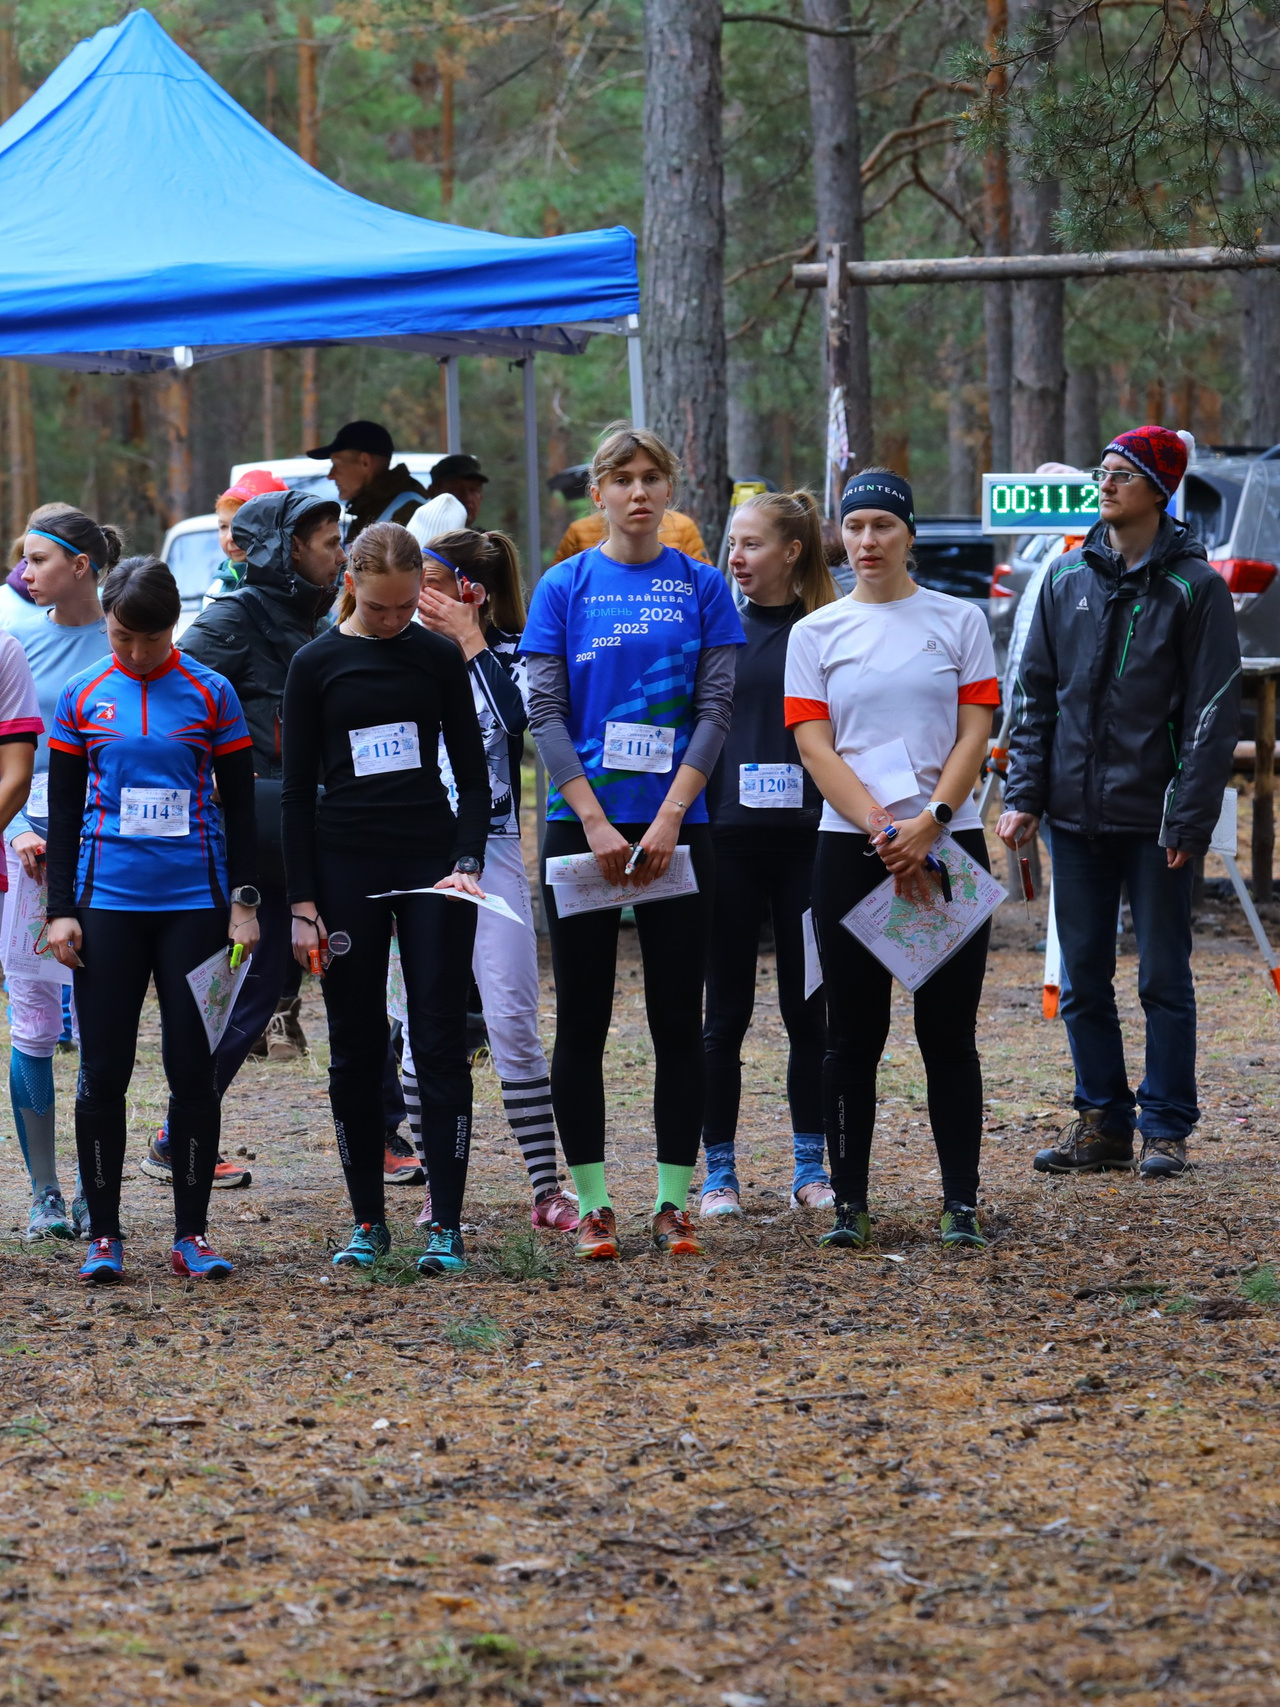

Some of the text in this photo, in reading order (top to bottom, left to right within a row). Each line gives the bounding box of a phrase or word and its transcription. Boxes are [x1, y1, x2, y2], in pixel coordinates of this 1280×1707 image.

[992, 484, 1099, 514] 00:11.2
[651, 578, 693, 596] 2025
[583, 593, 684, 604] ТРОПА ЗАЙЦЕВА
[584, 607, 633, 619] ТЮМЕНЬ
[639, 607, 684, 624] 2024
[613, 623, 649, 634] 2023
[591, 636, 622, 648] 2022
[575, 651, 597, 662] 2021
[373, 740, 401, 758] 112
[627, 740, 651, 757] 111
[758, 778, 786, 793] 120
[142, 803, 170, 820] 114
[455, 1115, 468, 1160] noname
